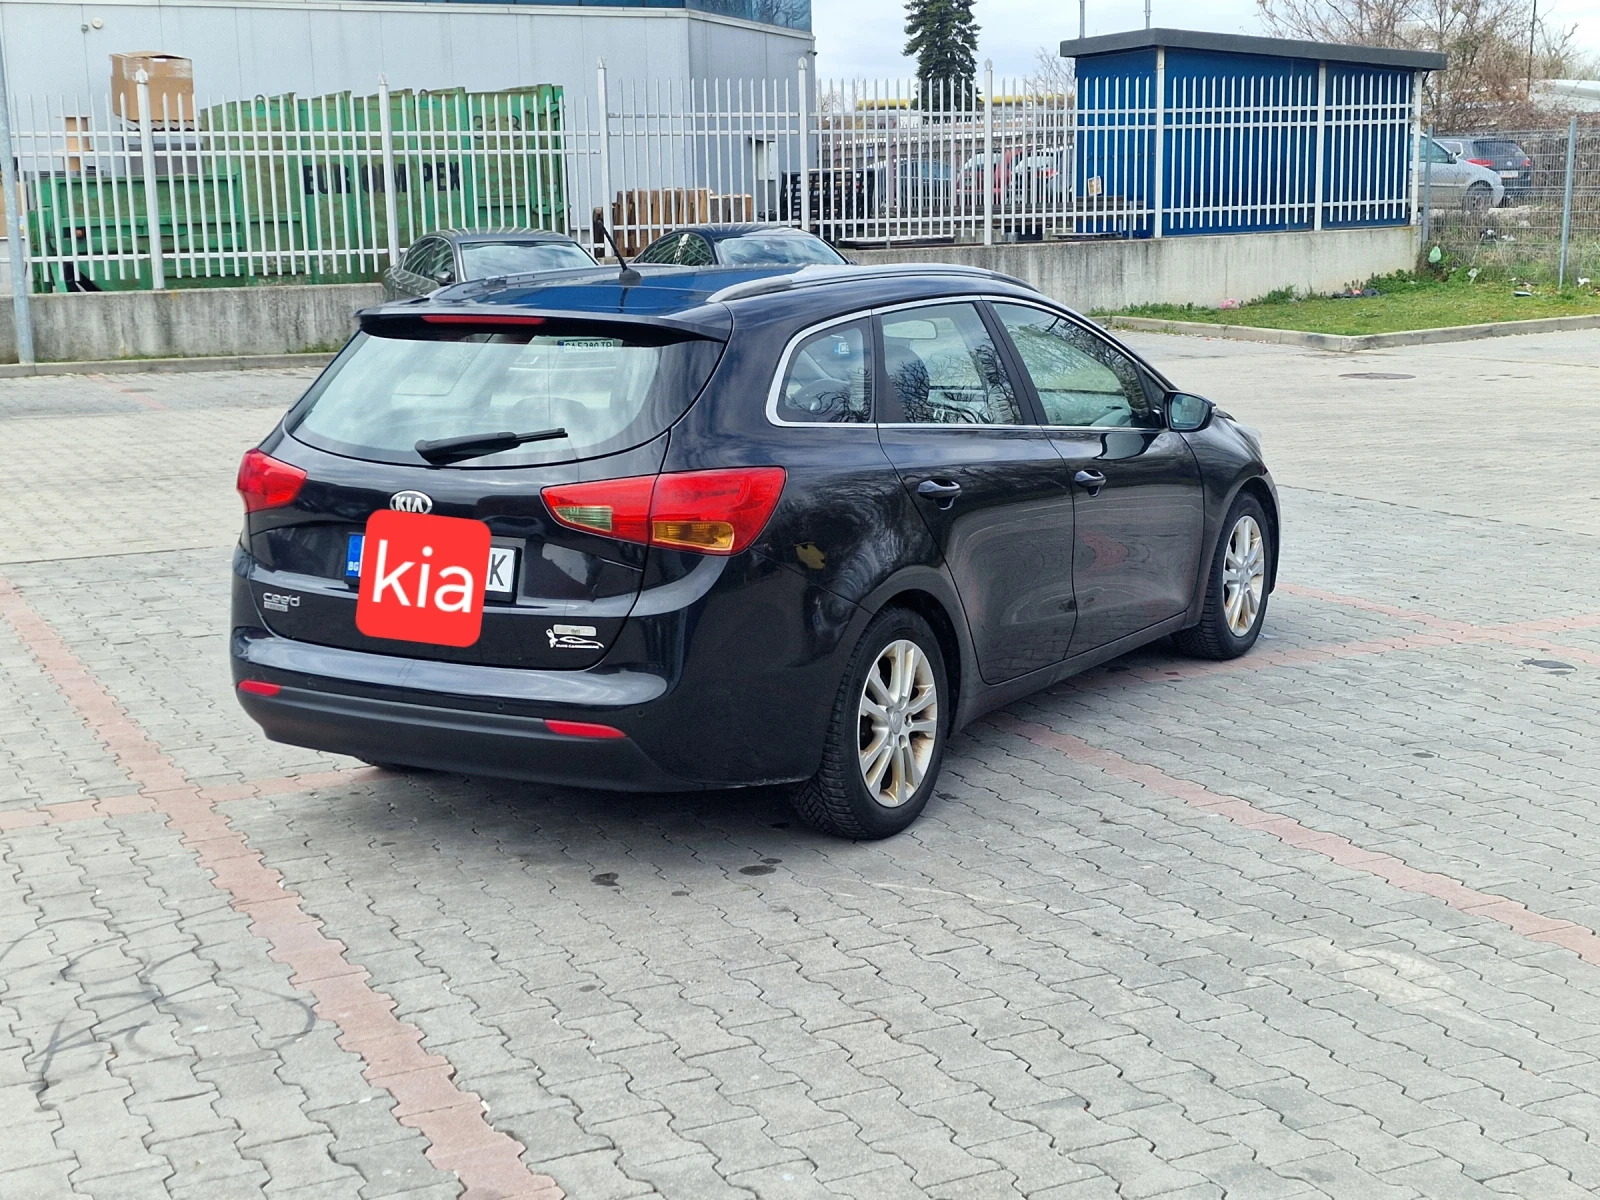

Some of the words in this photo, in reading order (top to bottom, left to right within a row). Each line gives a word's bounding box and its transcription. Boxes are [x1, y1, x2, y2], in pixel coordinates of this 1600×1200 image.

[395, 496, 424, 513] KIA
[347, 561, 360, 571] BG
[488, 553, 508, 587] K
